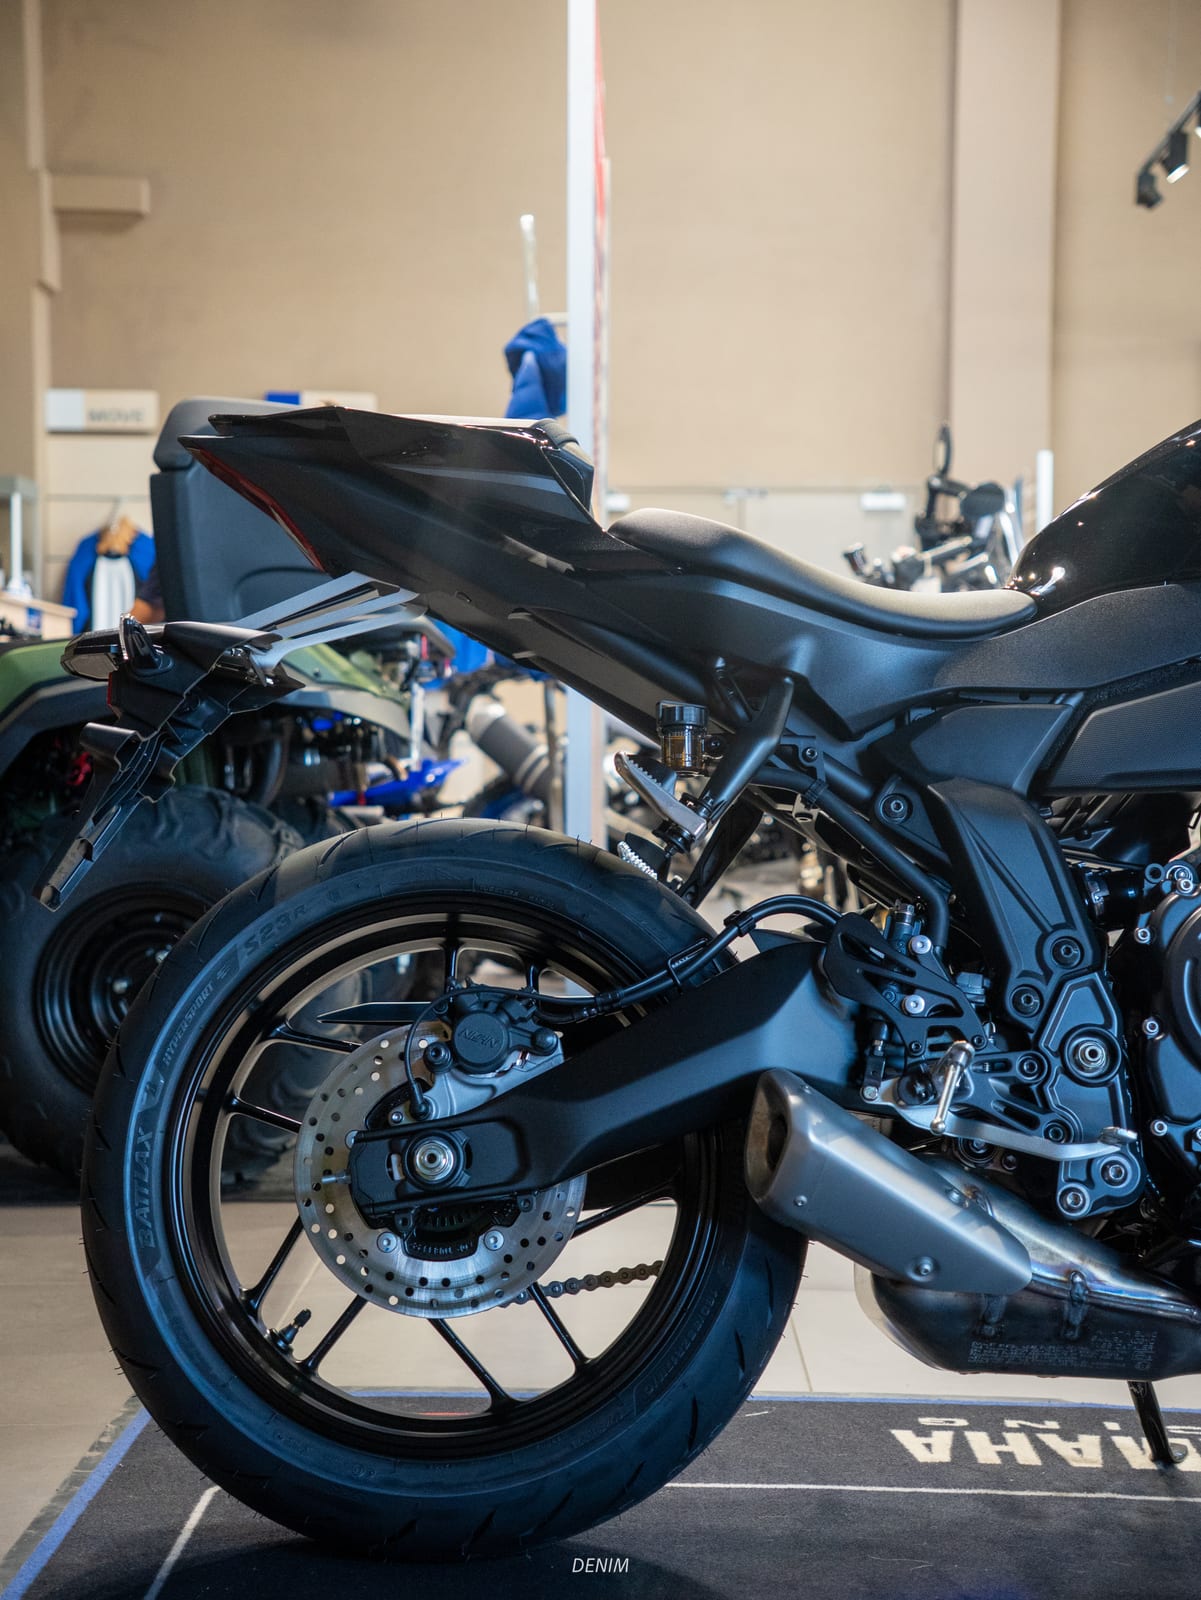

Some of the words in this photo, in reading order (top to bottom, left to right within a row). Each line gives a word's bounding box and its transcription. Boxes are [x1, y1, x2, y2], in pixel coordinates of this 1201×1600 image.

[134, 1128, 156, 1249] BATTLAX
[162, 982, 215, 1066] HYPERSPORT
[890, 1429, 1201, 1472] MAHA
